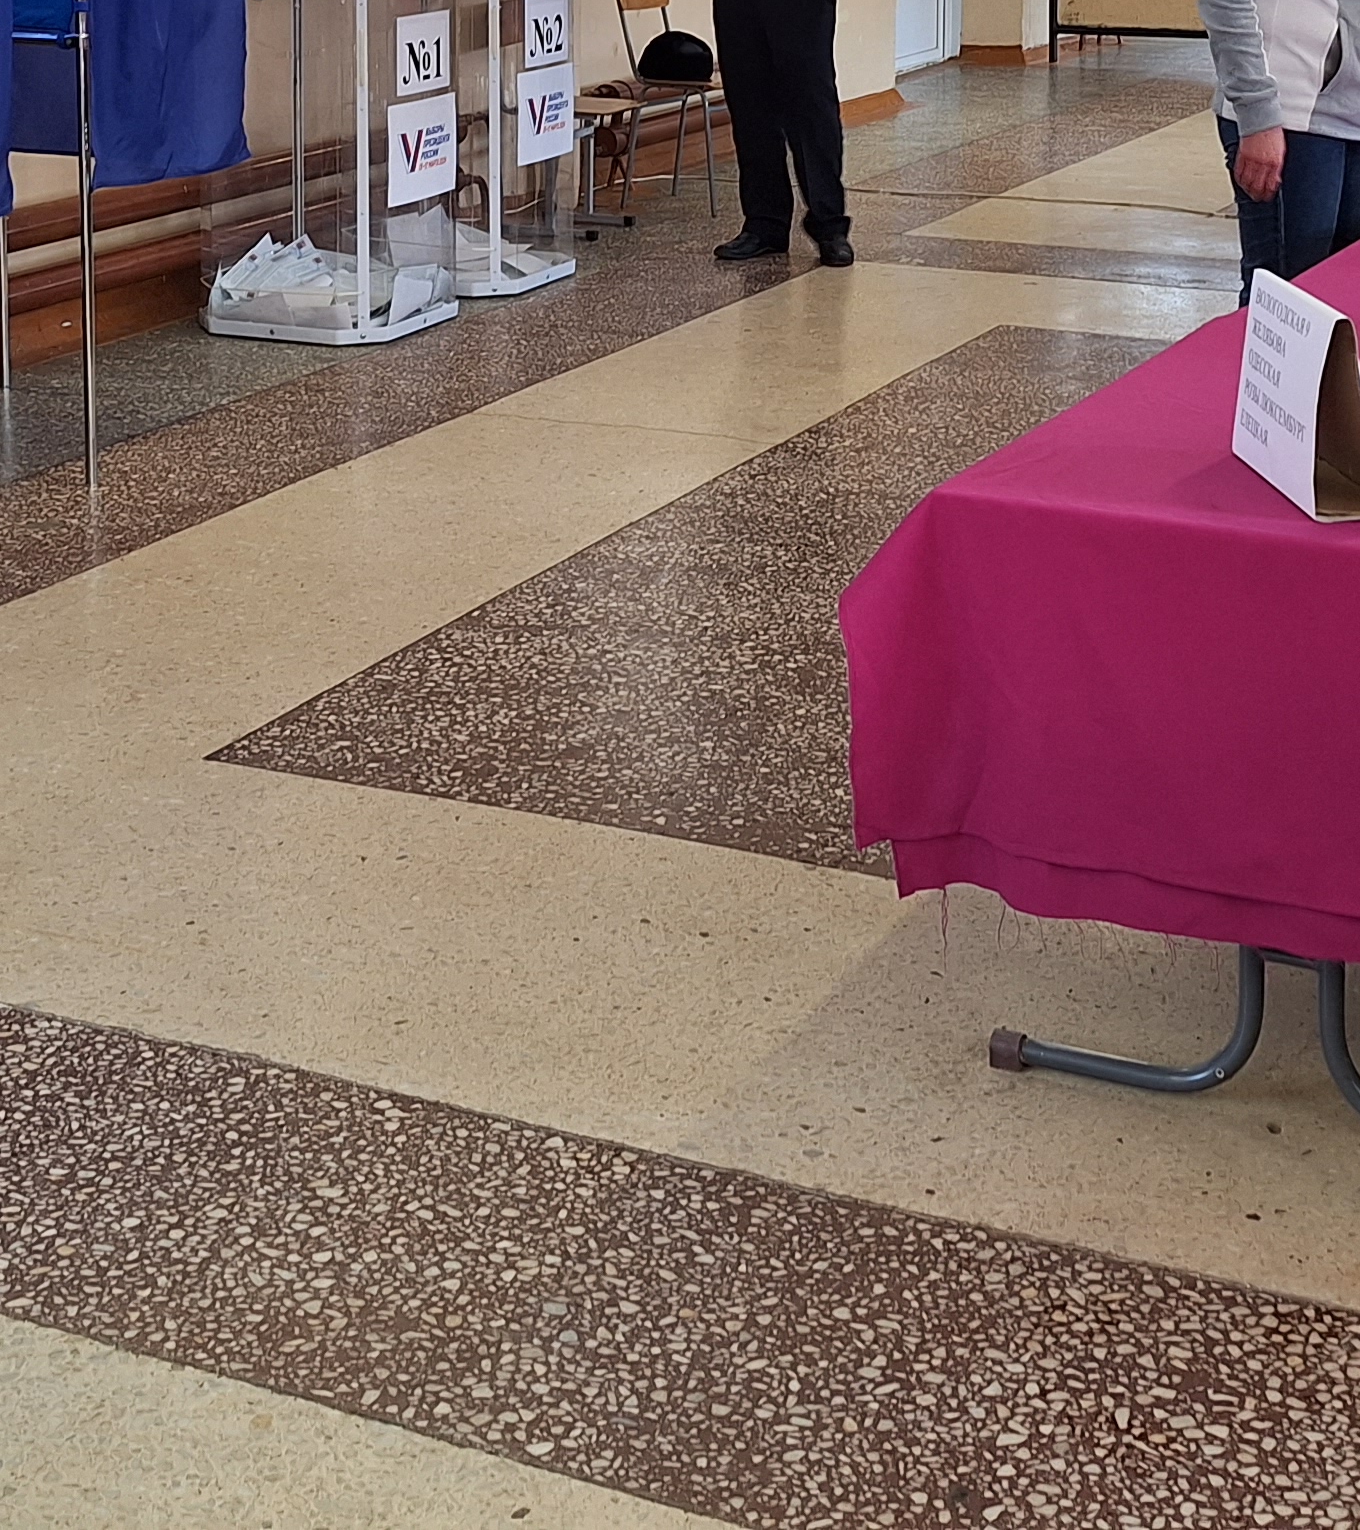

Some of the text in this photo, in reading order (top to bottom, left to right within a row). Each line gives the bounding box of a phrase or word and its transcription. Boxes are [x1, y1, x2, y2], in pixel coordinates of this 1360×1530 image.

[529, 14, 564, 58] №2
[402, 36, 443, 85] №1
[1255, 287, 1311, 337] ВОЛОГОДСКАЯ 9
[1252, 317, 1287, 359] ЖЕЛЯБОВА
[1248, 348, 1282, 389] ОДЕССКАЯ
[1240, 408, 1269, 448] ЕЛЕЦКАЯ
[1243, 378, 1307, 443] РОЗЫ ЛЮКСЕМБУРГ
